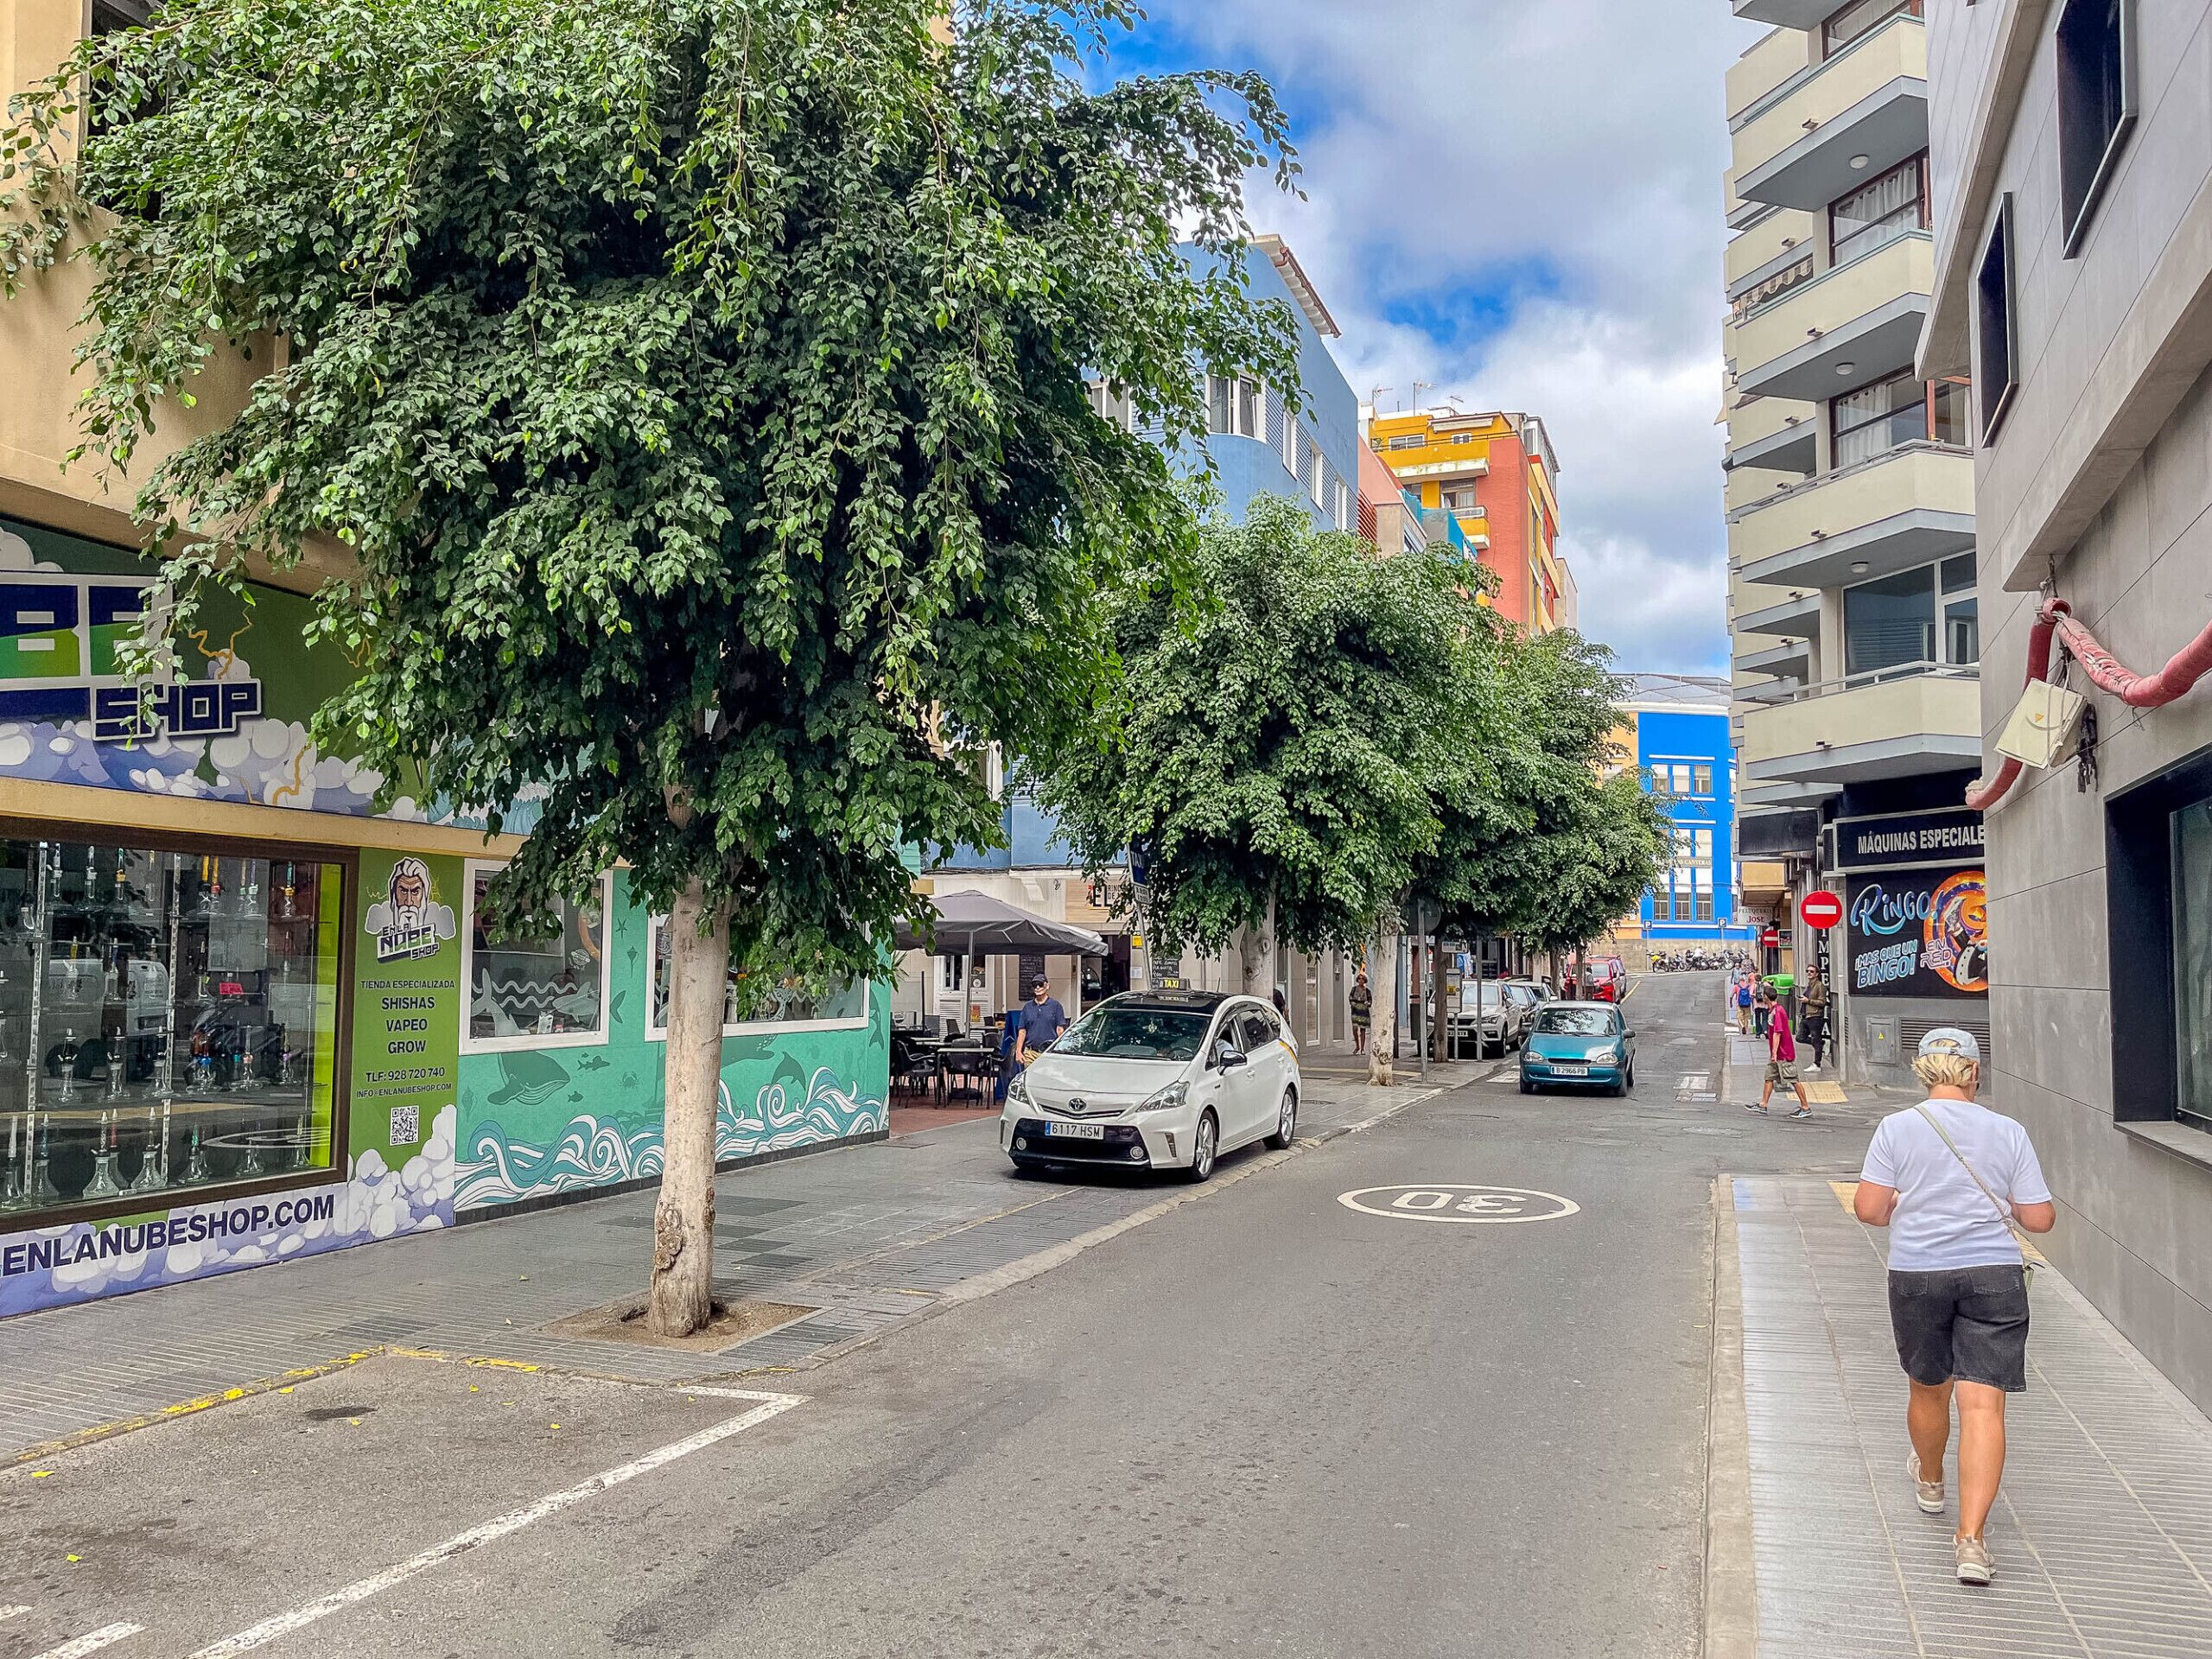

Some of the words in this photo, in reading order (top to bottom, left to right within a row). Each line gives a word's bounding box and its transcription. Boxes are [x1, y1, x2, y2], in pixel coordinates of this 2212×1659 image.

[93, 681, 259, 739] SHOP
[1858, 830, 1916, 854] MÁQUINAS
[411, 944, 439, 958] SHOP
[1879, 944, 1902, 962] QUE
[1902, 939, 1918, 956] UN
[1927, 939, 1947, 951] EN
[1920, 950, 1952, 969] RED
[1857, 953, 1916, 988] BINGO!
[360, 981, 391, 989] TIENDA
[393, 980, 454, 988] ESPECIALIZADA
[1164, 979, 1179, 988] TAXI
[381, 996, 435, 1009] SHISHAS
[386, 1019, 428, 1032] VAPEO
[388, 1040, 426, 1054] GROW
[365, 1071, 386, 1083] TLF:
[388, 1070, 407, 1081] 928
[409, 1068, 426, 1079] 720
[428, 1067, 445, 1077] 740
[1052, 1124, 1077, 1135] 6117
[1080, 1126, 1100, 1137] HSM
[3, 1194, 334, 1276] ENLANUBESHOP.COM
